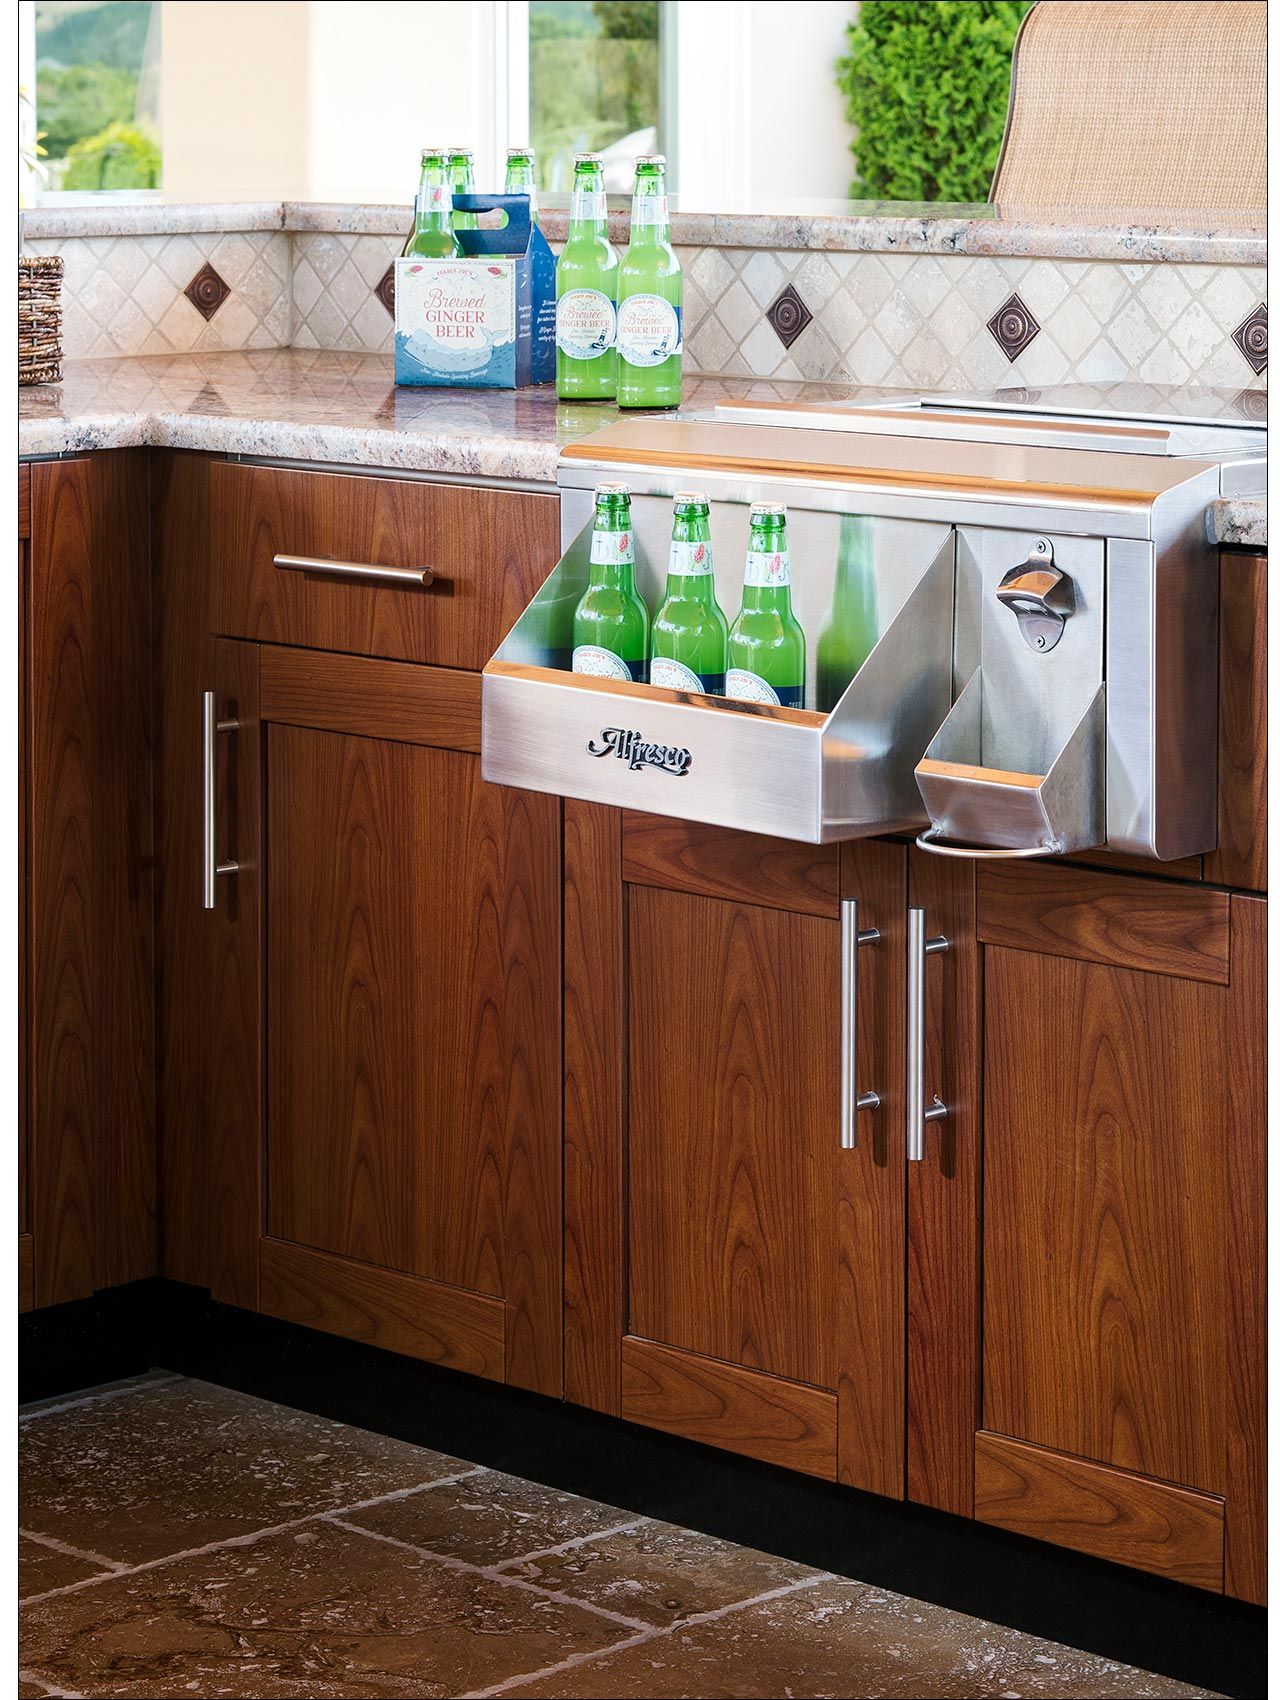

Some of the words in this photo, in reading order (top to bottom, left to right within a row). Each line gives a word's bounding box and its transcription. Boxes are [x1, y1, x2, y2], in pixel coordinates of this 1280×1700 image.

[423, 287, 487, 309] Brewed
[425, 310, 485, 323] GINGER
[589, 319, 610, 328] BEER
[651, 325, 672, 334] BEER
[436, 325, 475, 338] BEER
[586, 727, 693, 776] Alfresco
